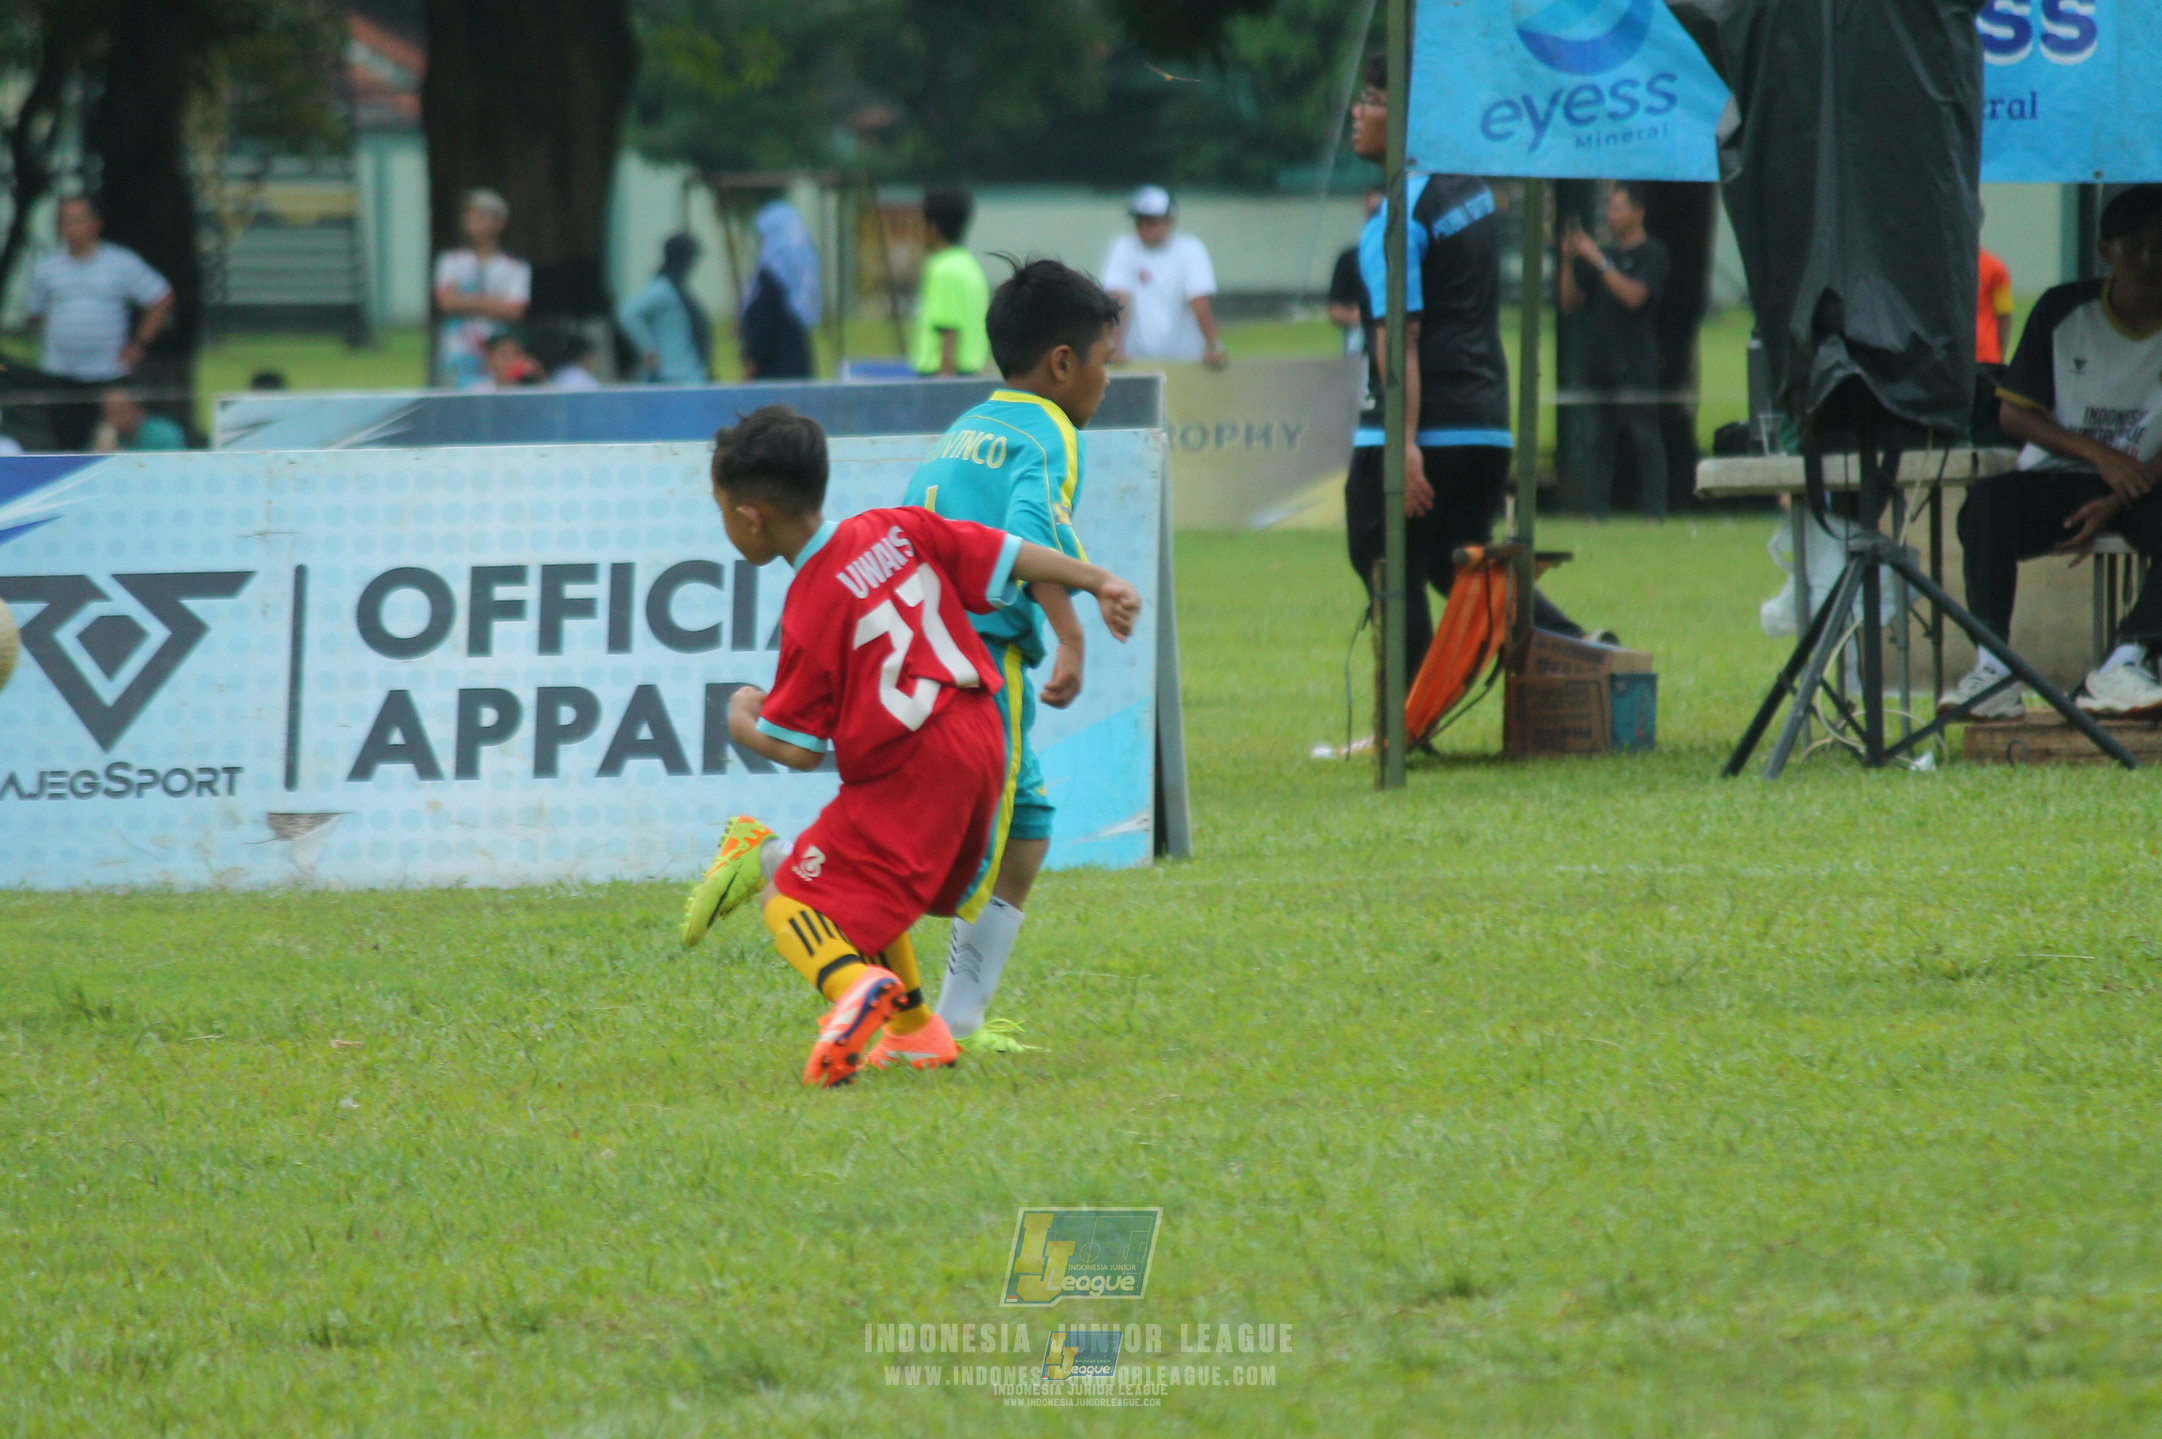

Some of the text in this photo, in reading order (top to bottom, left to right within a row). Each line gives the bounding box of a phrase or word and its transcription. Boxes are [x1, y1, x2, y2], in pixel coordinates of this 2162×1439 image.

[1481, 73, 1678, 155] eyess
[1576, 122, 1669, 150] Mineral
[1984, 91, 2038, 120] ral
[836, 525, 915, 599] UWAIS
[356, 560, 782, 660] OFFICI
[853, 562, 980, 732] 27
[346, 682, 836, 782] APPAR
